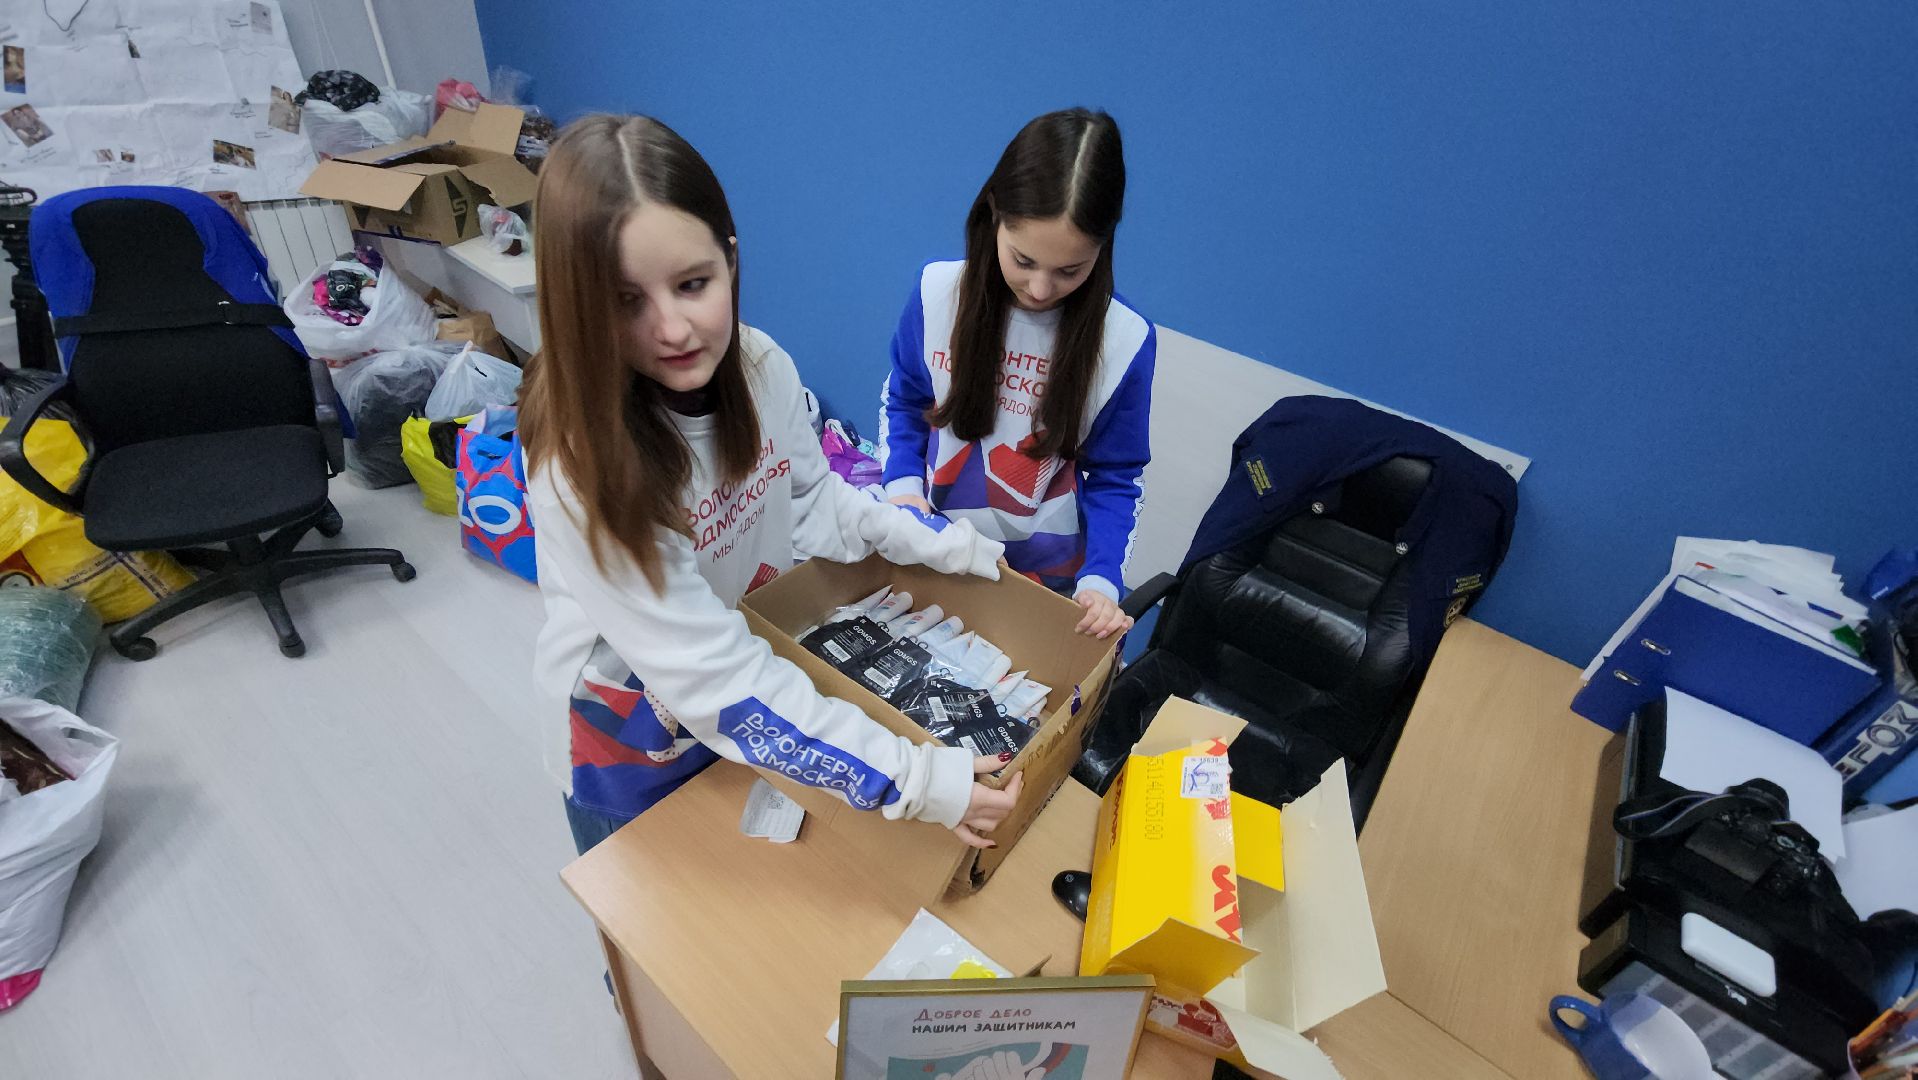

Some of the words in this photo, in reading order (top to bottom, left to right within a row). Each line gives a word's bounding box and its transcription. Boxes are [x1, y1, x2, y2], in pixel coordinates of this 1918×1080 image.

[997, 726, 1019, 753] GDMGS
[913, 1008, 982, 1022] ДОБРОЕ
[989, 1008, 1032, 1019] ДЕЛО
[912, 1023, 967, 1034] НАШИМ
[974, 1020, 1076, 1033] ЗАЩИТНИКАМ
